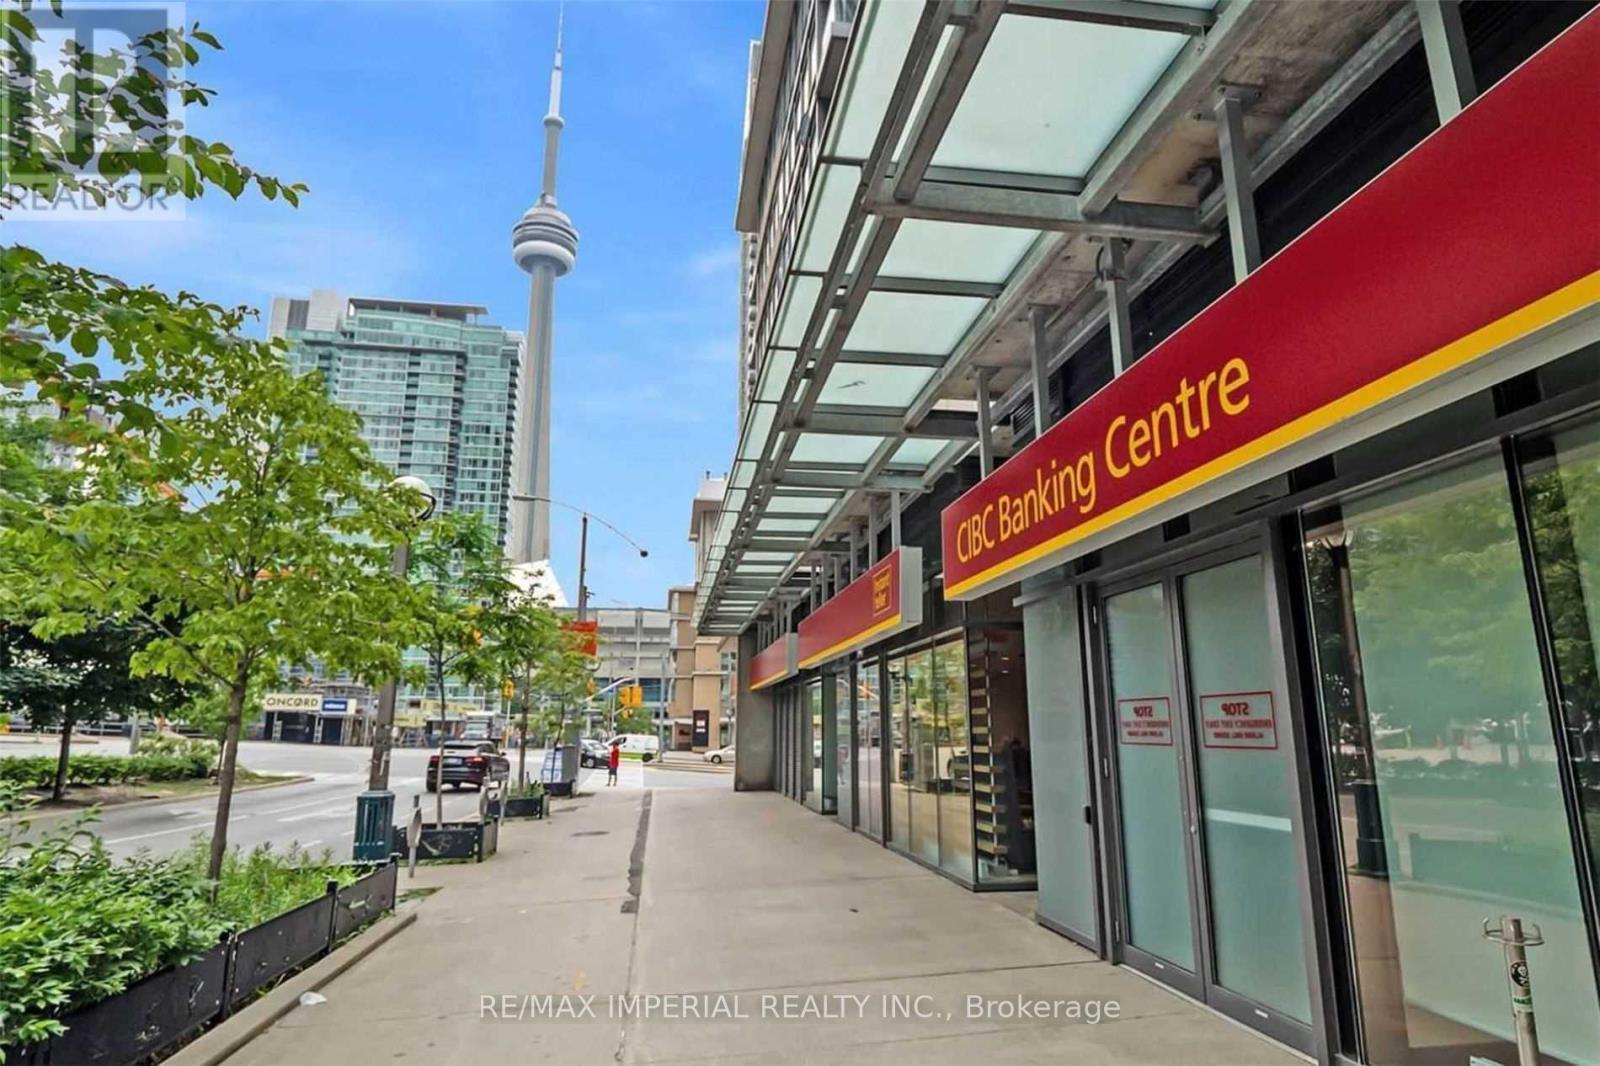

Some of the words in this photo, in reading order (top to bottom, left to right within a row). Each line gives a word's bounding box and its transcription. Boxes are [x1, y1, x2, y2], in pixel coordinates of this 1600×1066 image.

[957, 504, 995, 563] CIBC
[999, 451, 1097, 542] Banking
[1105, 357, 1250, 479] Centre
